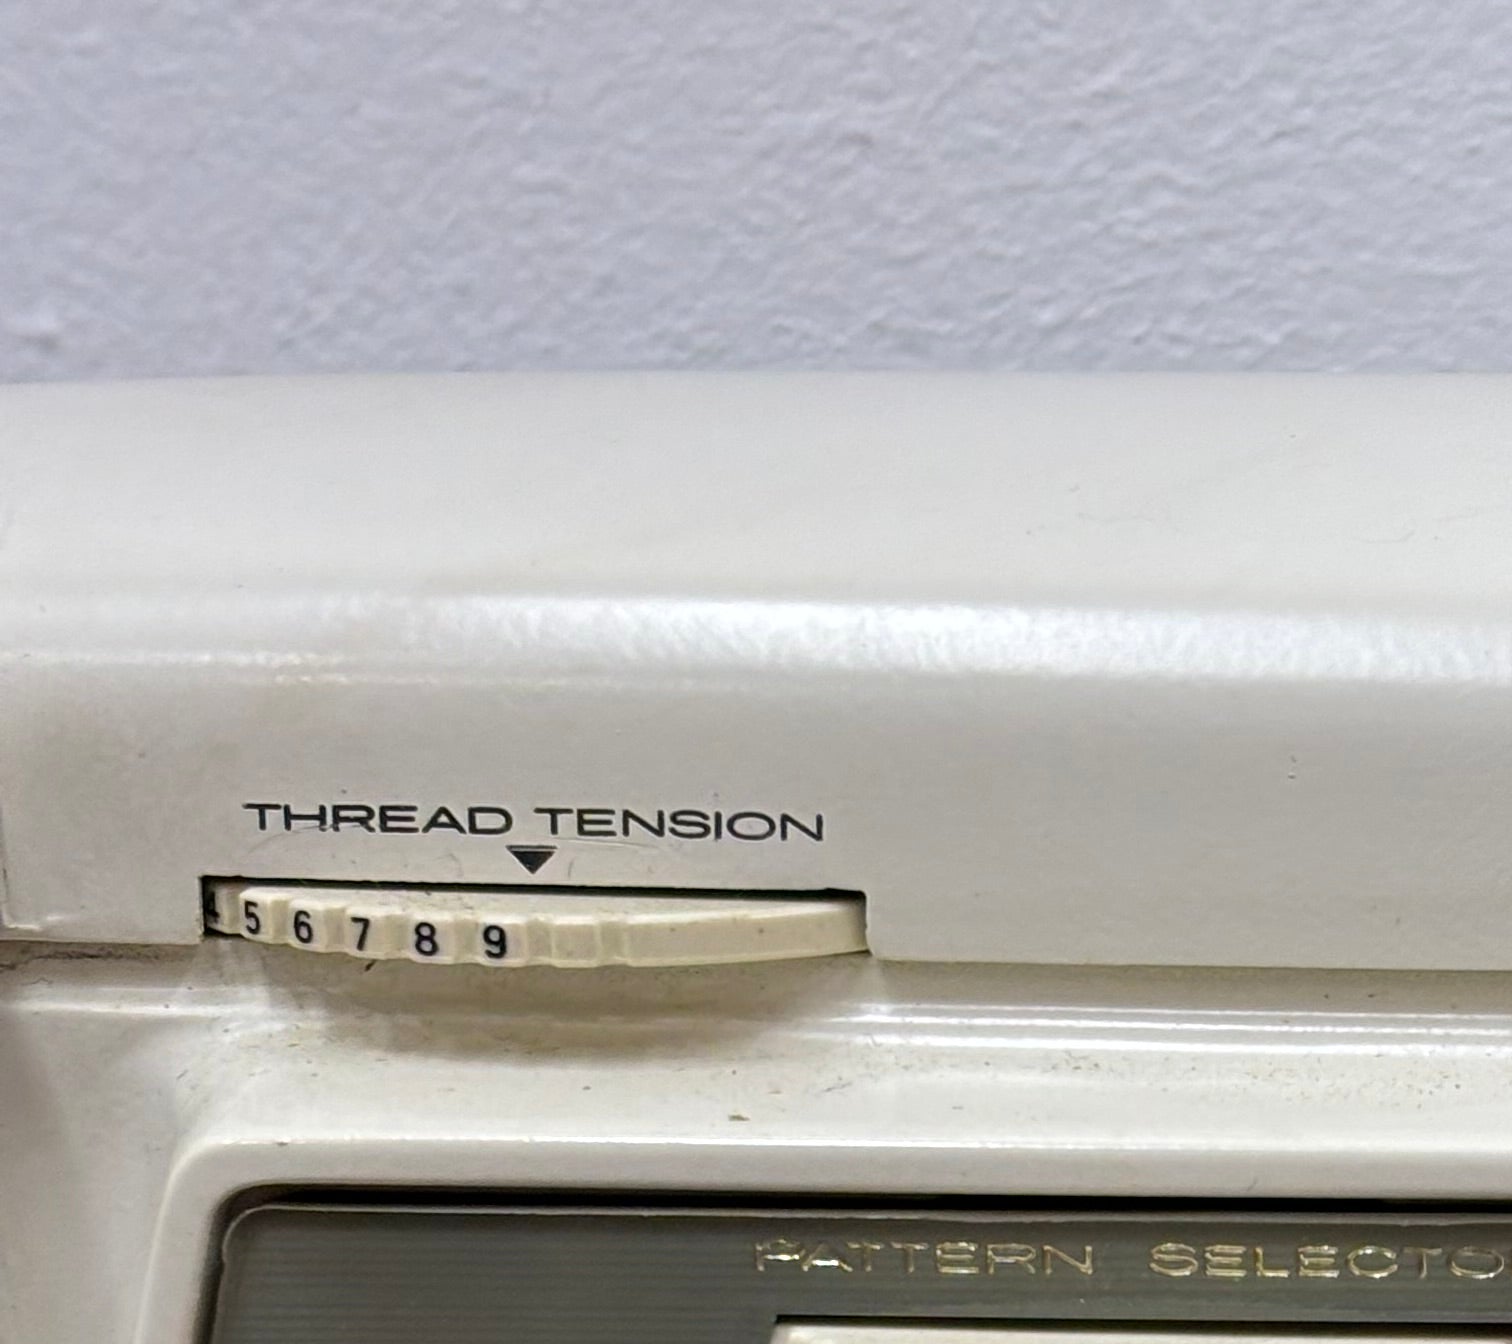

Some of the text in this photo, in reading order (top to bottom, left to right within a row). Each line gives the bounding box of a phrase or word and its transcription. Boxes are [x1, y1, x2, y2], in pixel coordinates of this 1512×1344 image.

[243, 802, 824, 842] THREAD TENSION
[244, 900, 262, 936] 5
[294, 910, 314, 945] 6
[350, 917, 370, 951] 7
[414, 922, 439, 957] 8
[482, 925, 508, 959] 9
[754, 1238, 1095, 1276] PATTERN
